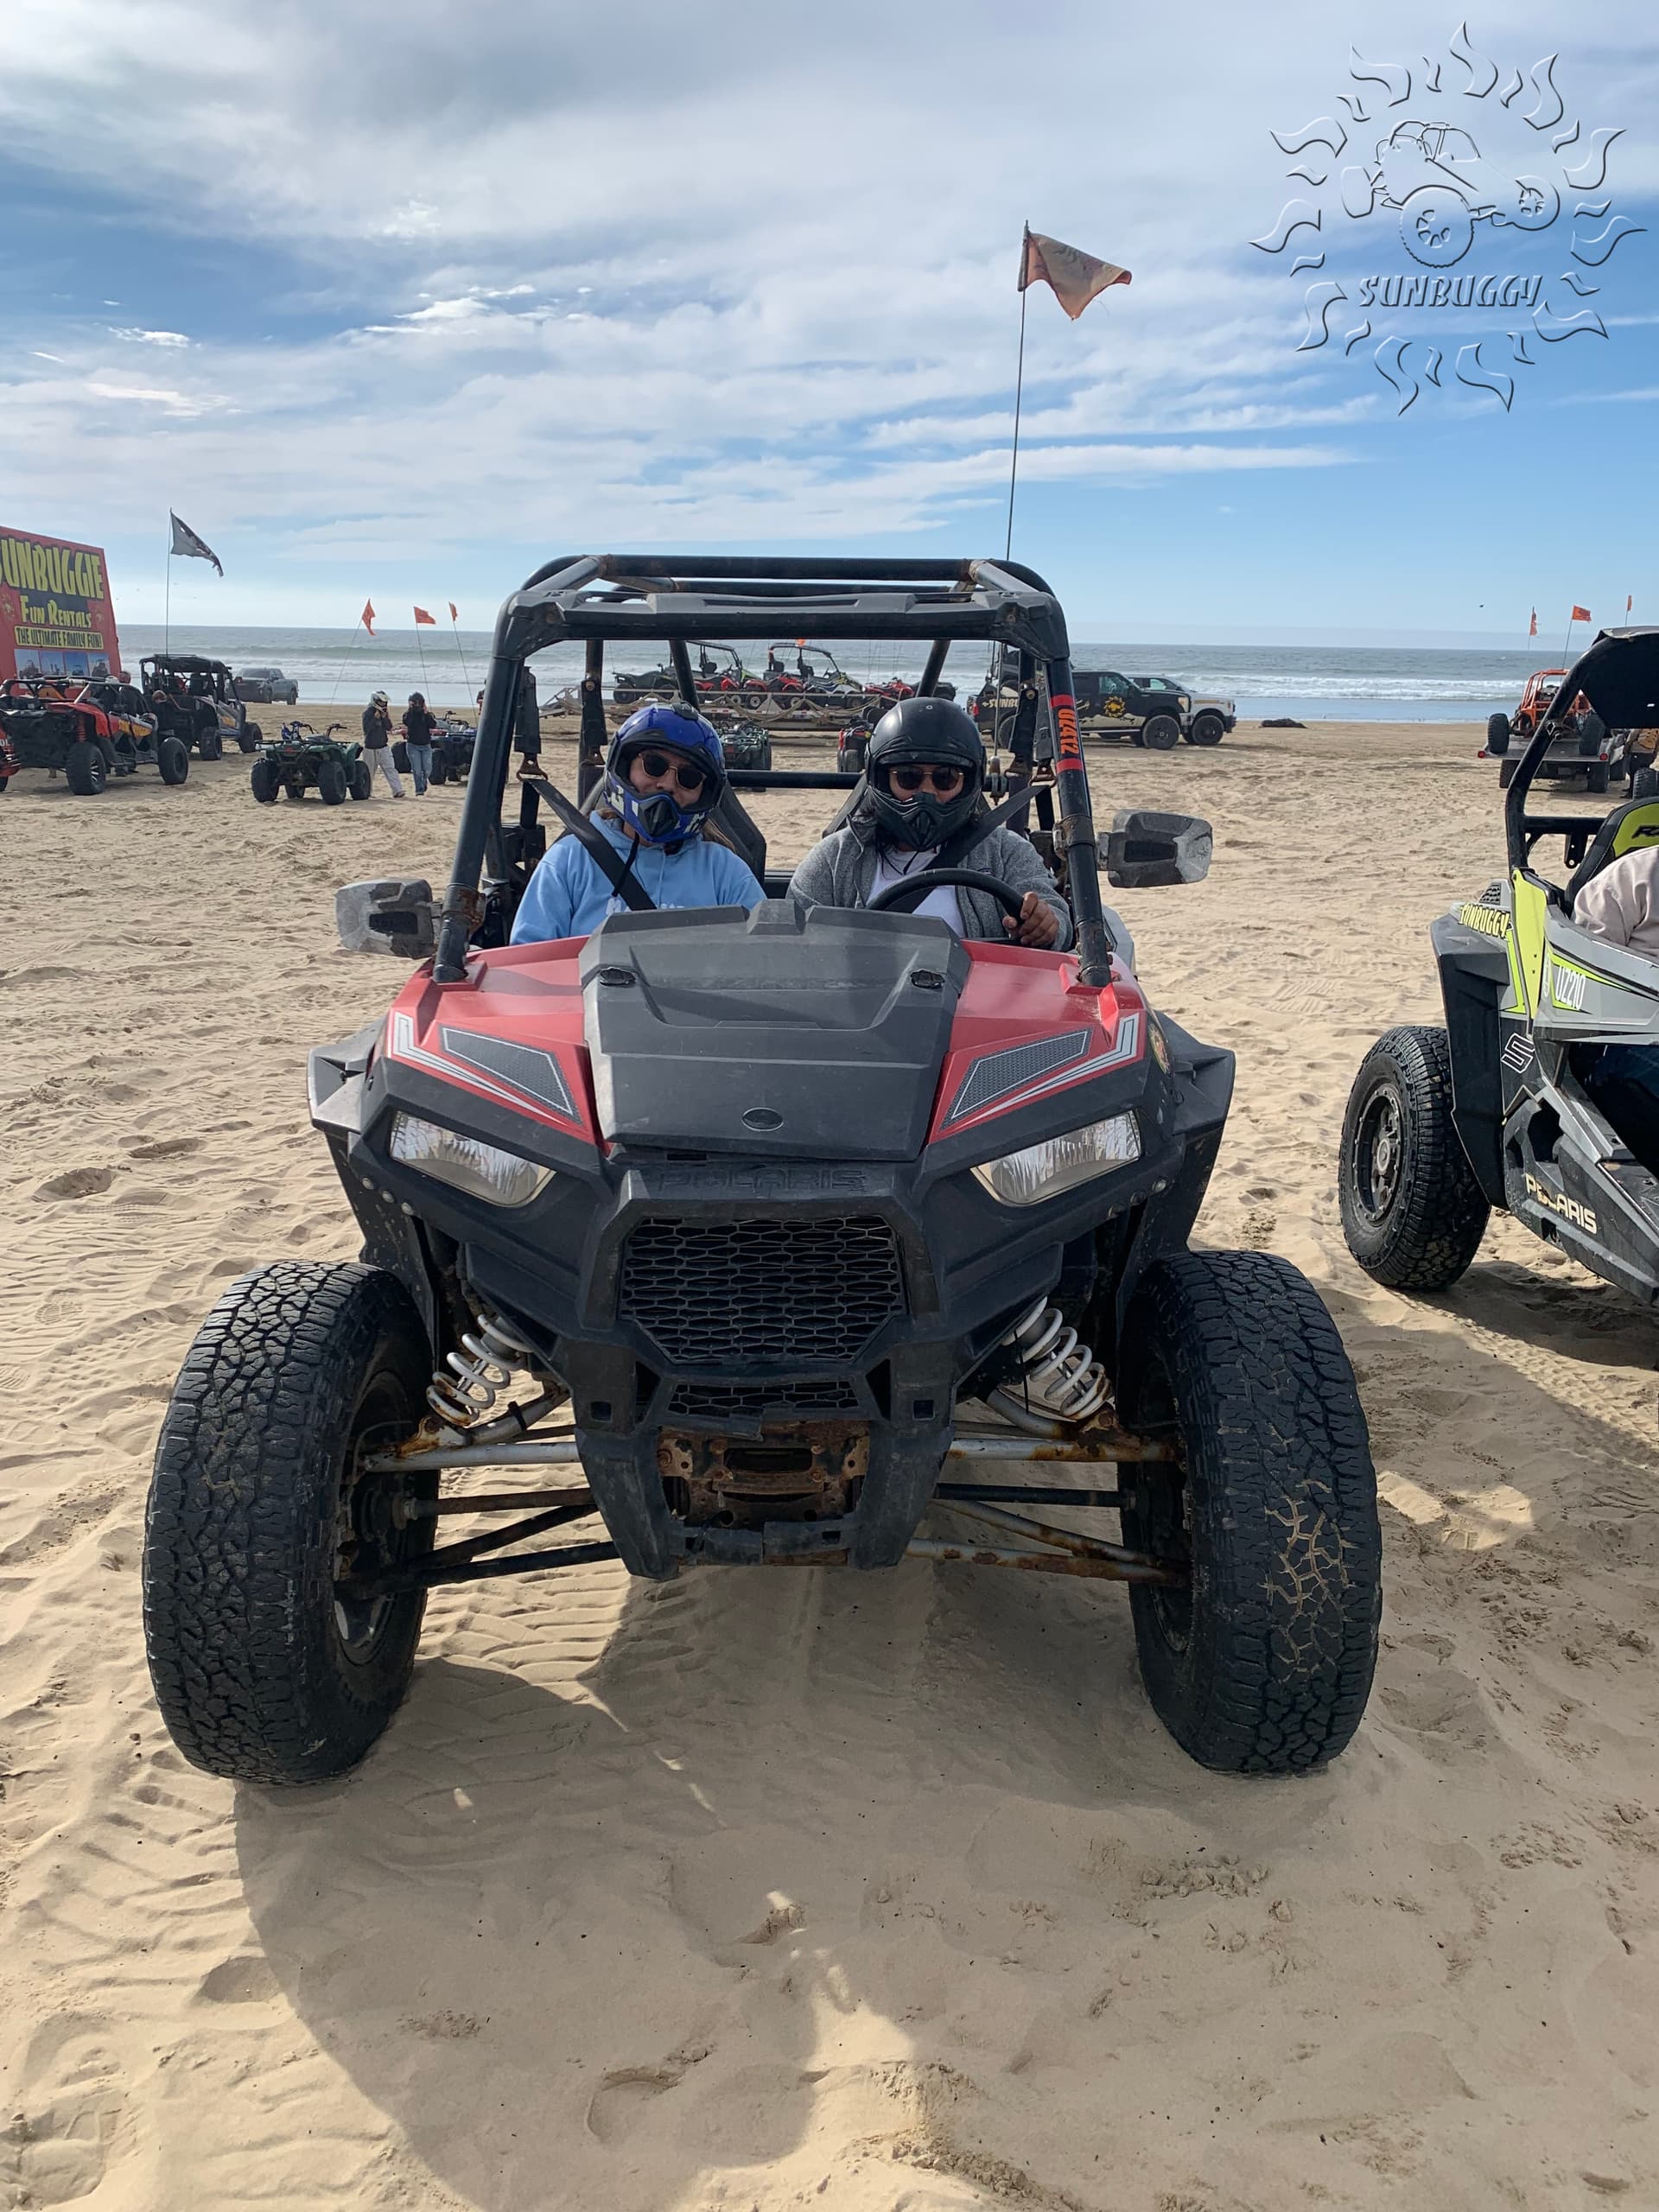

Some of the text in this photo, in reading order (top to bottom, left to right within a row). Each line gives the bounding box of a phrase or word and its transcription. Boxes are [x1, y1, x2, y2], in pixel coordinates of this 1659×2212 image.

[0, 538, 105, 600] UNBUGGIE
[16, 627, 29, 645] THE
[31, 629, 61, 646] ULTIMATE
[63, 632, 87, 648] FAMILY
[1459, 903, 1510, 939] SUNBUGGY
